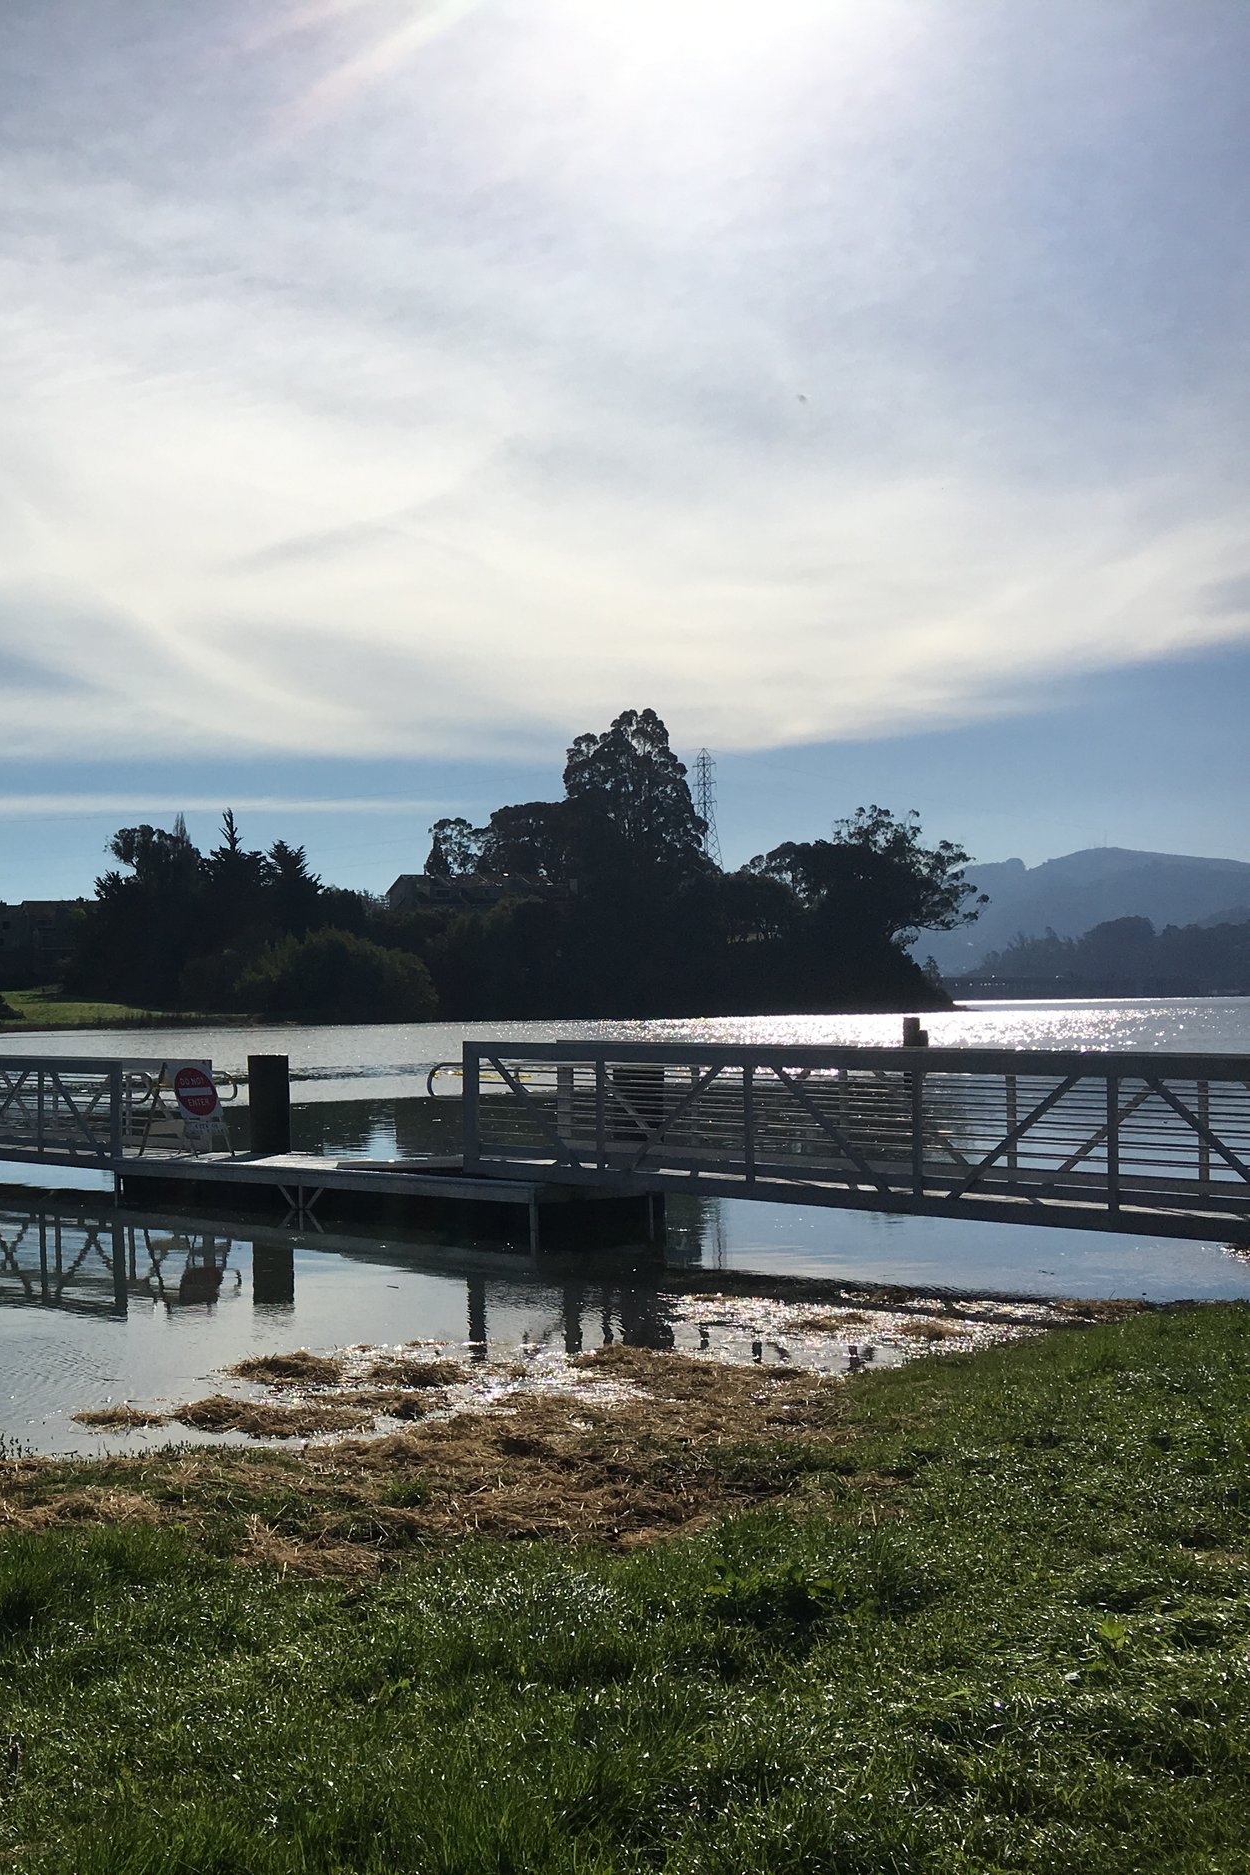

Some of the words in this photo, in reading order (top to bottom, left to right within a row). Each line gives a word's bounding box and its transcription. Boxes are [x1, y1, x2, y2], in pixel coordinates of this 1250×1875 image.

[179, 1077, 190, 1086] DO
[190, 1077, 205, 1086] NOT
[187, 1097, 210, 1107] ENTER
